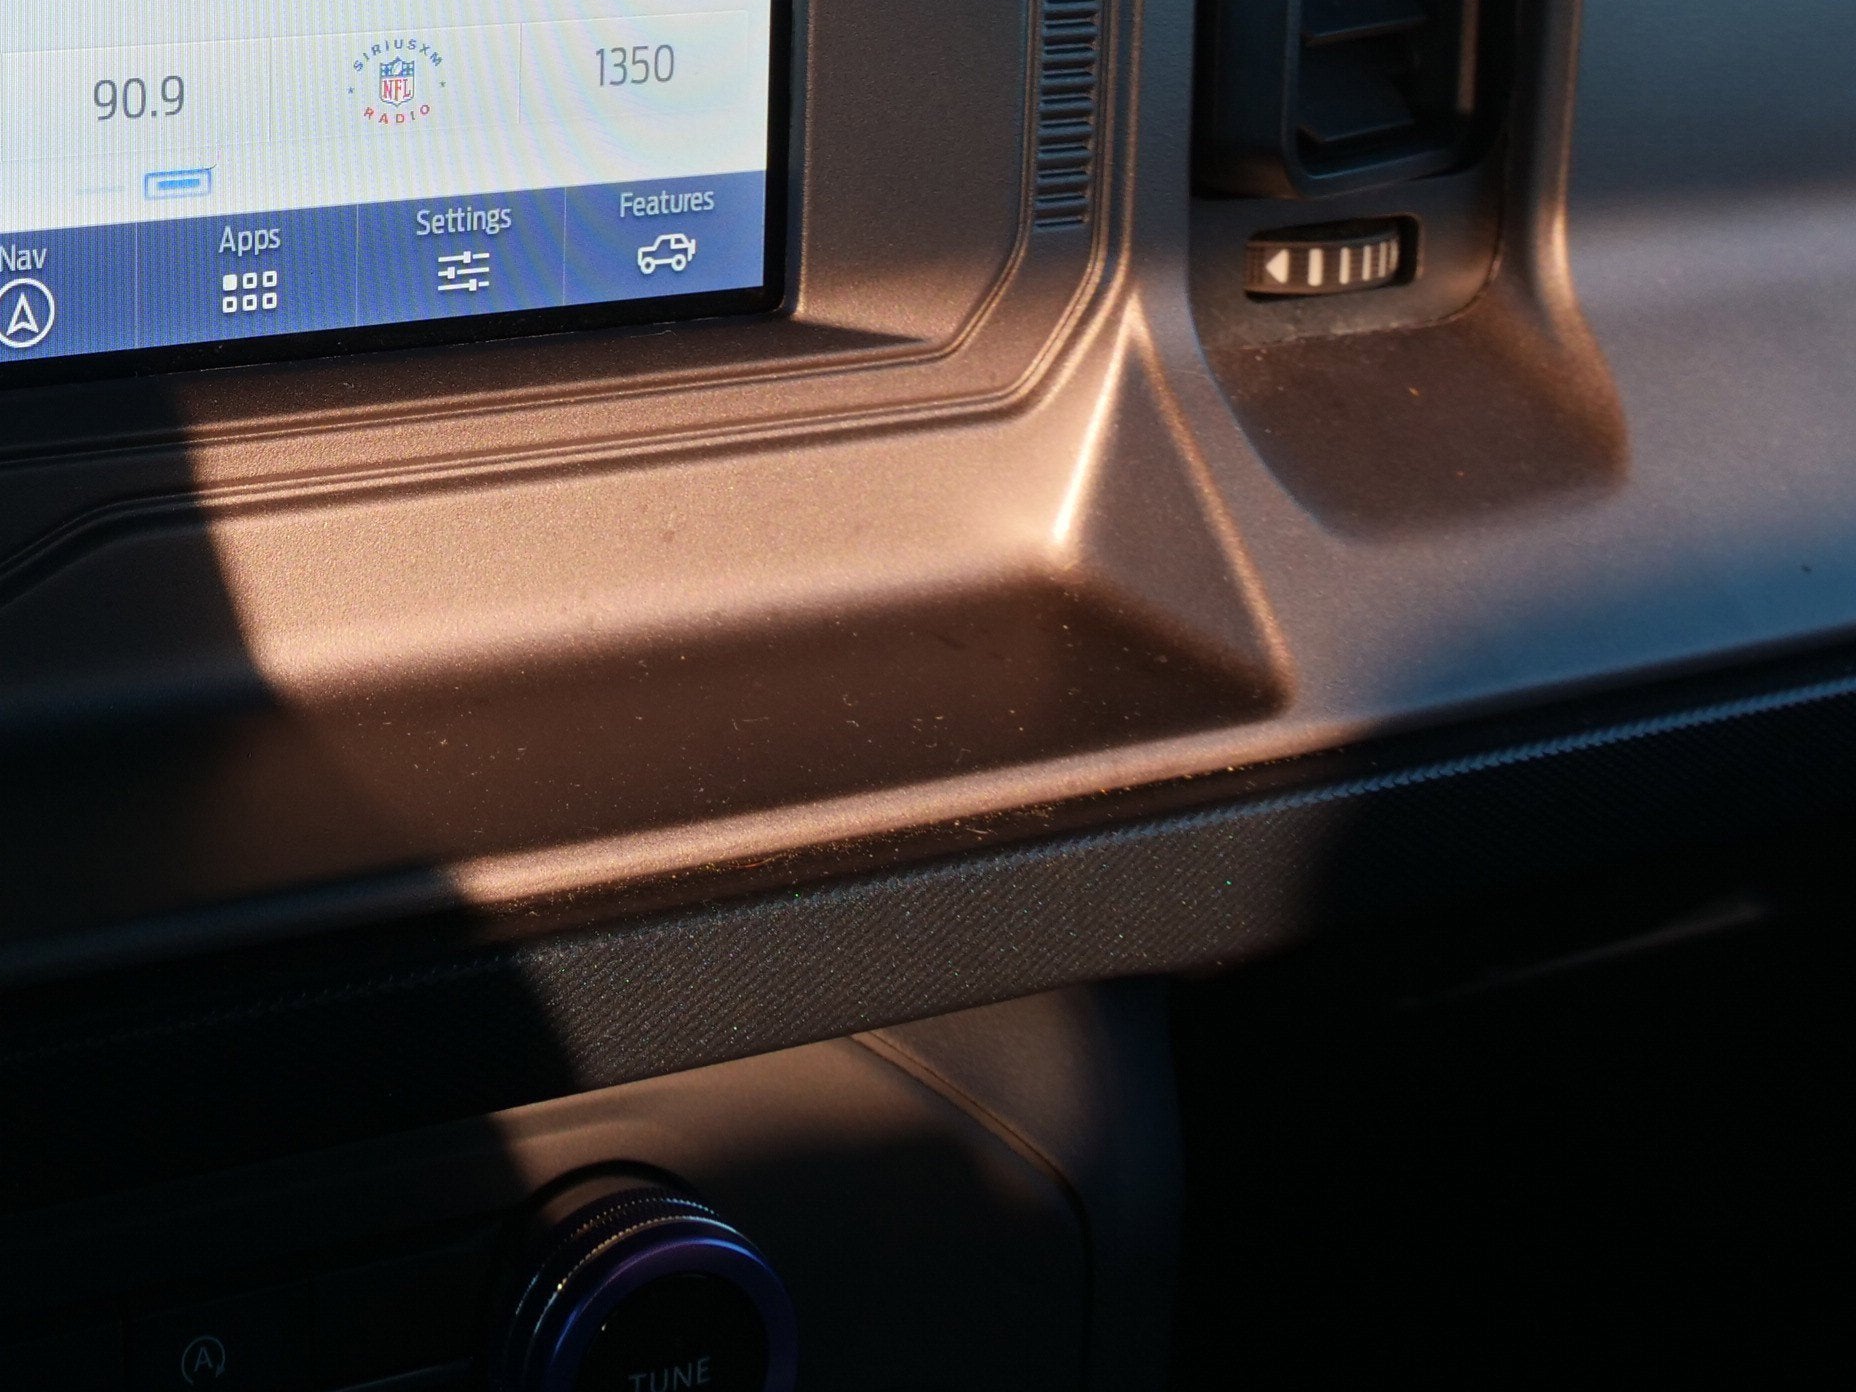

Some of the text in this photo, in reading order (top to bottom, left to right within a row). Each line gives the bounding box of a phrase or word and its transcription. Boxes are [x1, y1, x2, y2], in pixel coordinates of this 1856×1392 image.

[352, 37, 445, 74] SIRIUSXM
[594, 43, 676, 87] 1350
[93, 74, 186, 122] 90.9
[381, 77, 413, 102] NFL
[362, 103, 432, 126] RADIO
[618, 188, 715, 217] Features
[415, 207, 513, 238] Settings
[218, 225, 282, 256] Apps
[627, 1355, 712, 1392] TUNE
